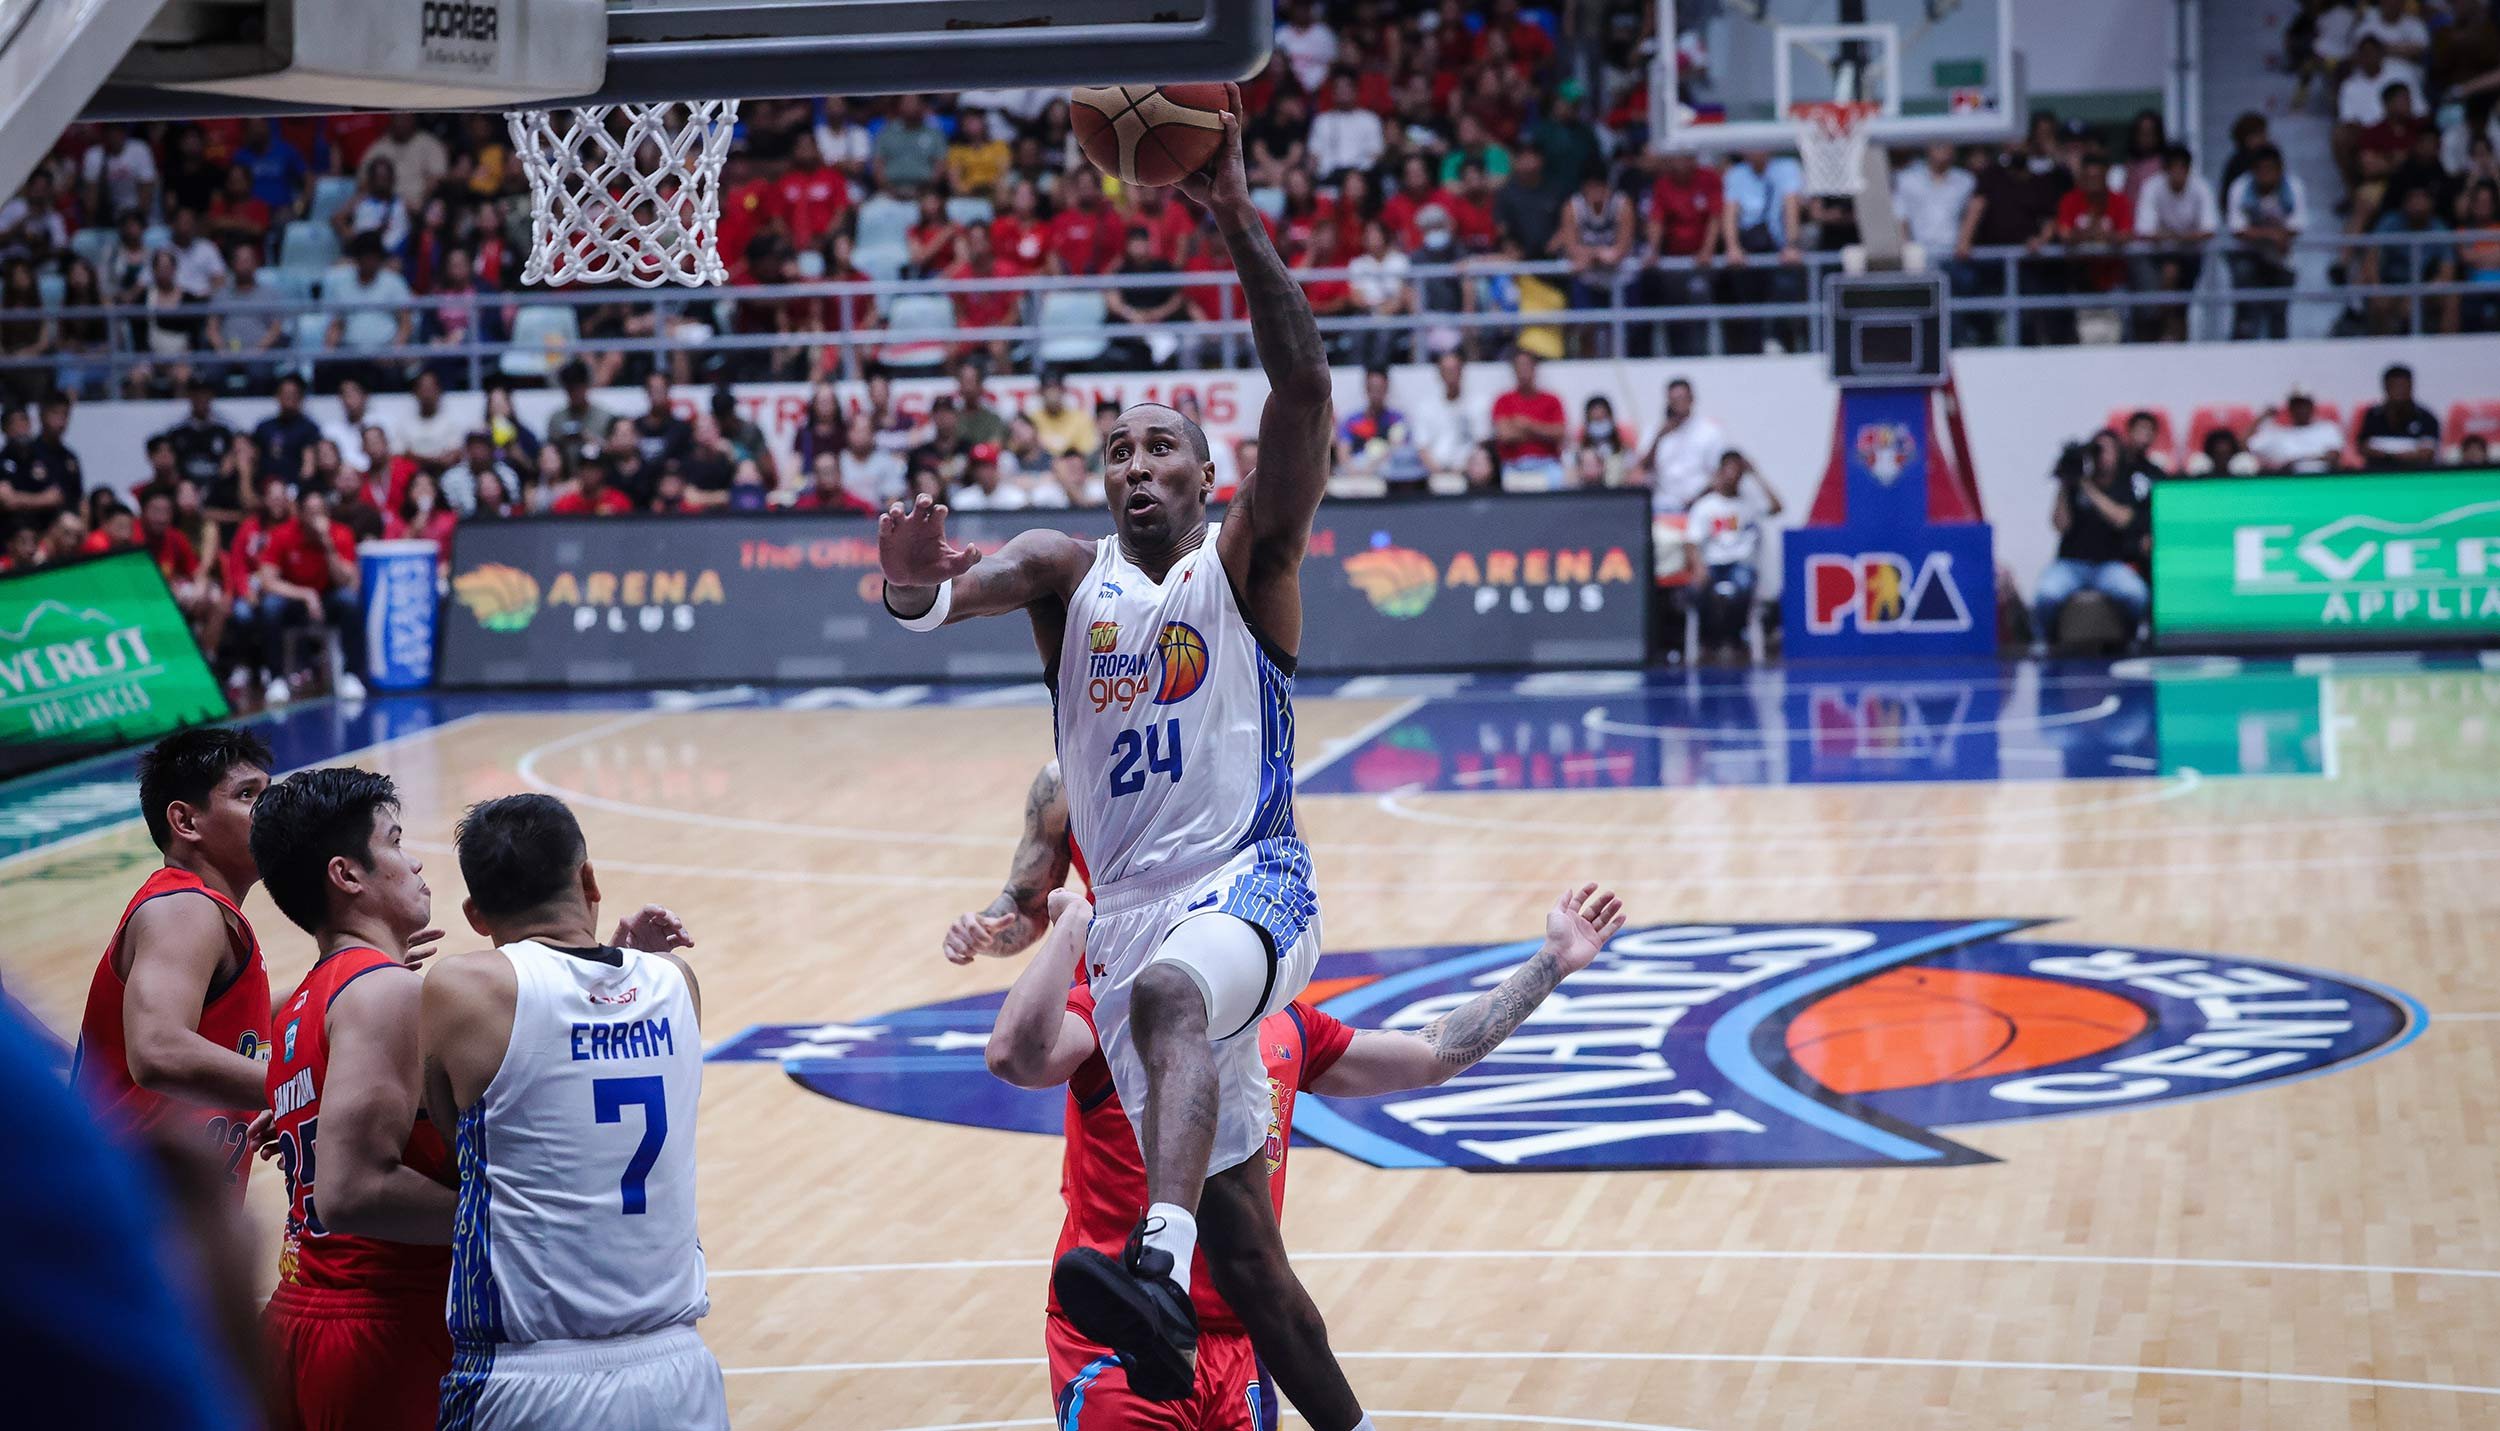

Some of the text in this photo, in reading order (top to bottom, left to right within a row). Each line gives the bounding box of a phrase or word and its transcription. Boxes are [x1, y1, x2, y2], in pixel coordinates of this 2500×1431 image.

[1445, 546, 1634, 588] ARENA
[548, 570, 726, 608] ARENA
[1474, 583, 1605, 615] PLUS
[1804, 552, 1974, 635] PBA
[573, 605, 696, 633] PLUS
[1089, 625, 1123, 650] TNT
[0, 625, 151, 698] VEREST
[1089, 650, 1156, 678] TROPAN
[1109, 718, 1183, 798] 24
[1989, 949, 2353, 1104] CENTER
[592, 1075, 668, 1215] 7
